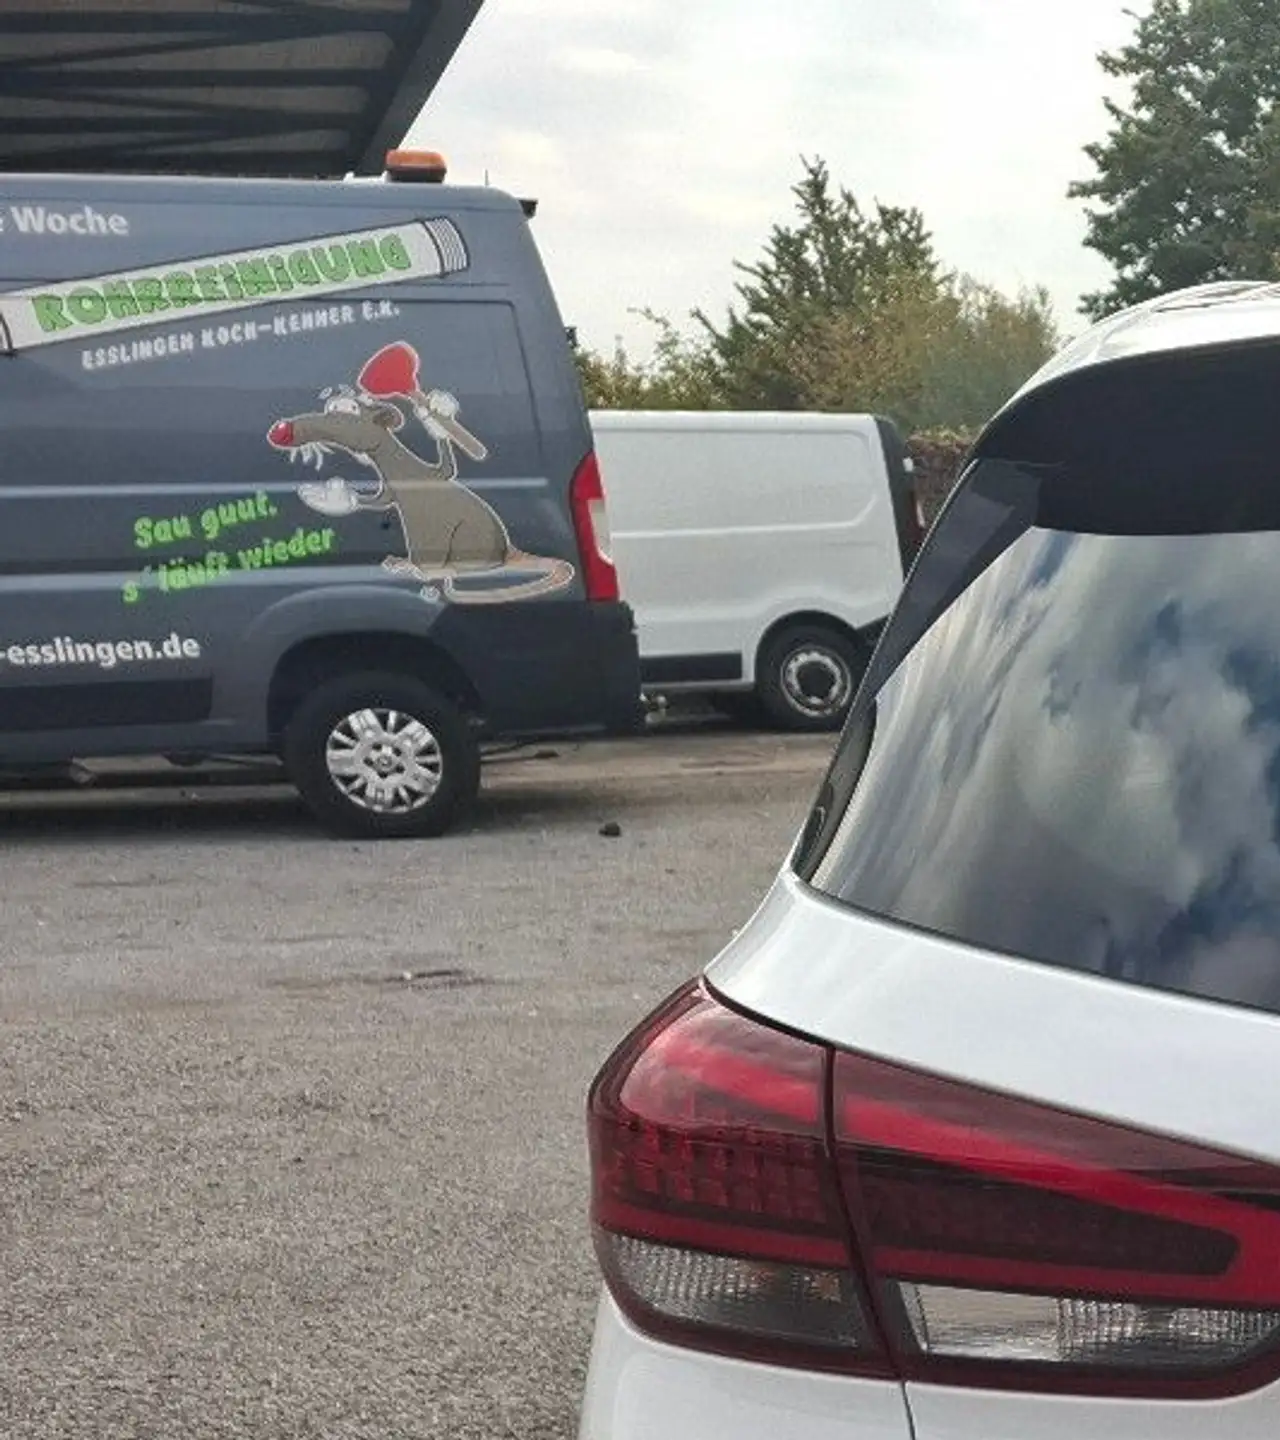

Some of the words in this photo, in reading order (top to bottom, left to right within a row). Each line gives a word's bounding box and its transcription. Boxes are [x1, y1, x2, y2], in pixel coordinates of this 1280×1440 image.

[10, 205, 129, 236] Woche
[81, 332, 194, 370] ESSLINGEN
[134, 515, 191, 549] Sau
[158, 552, 230, 592] läuft
[237, 527, 335, 571] wieder
